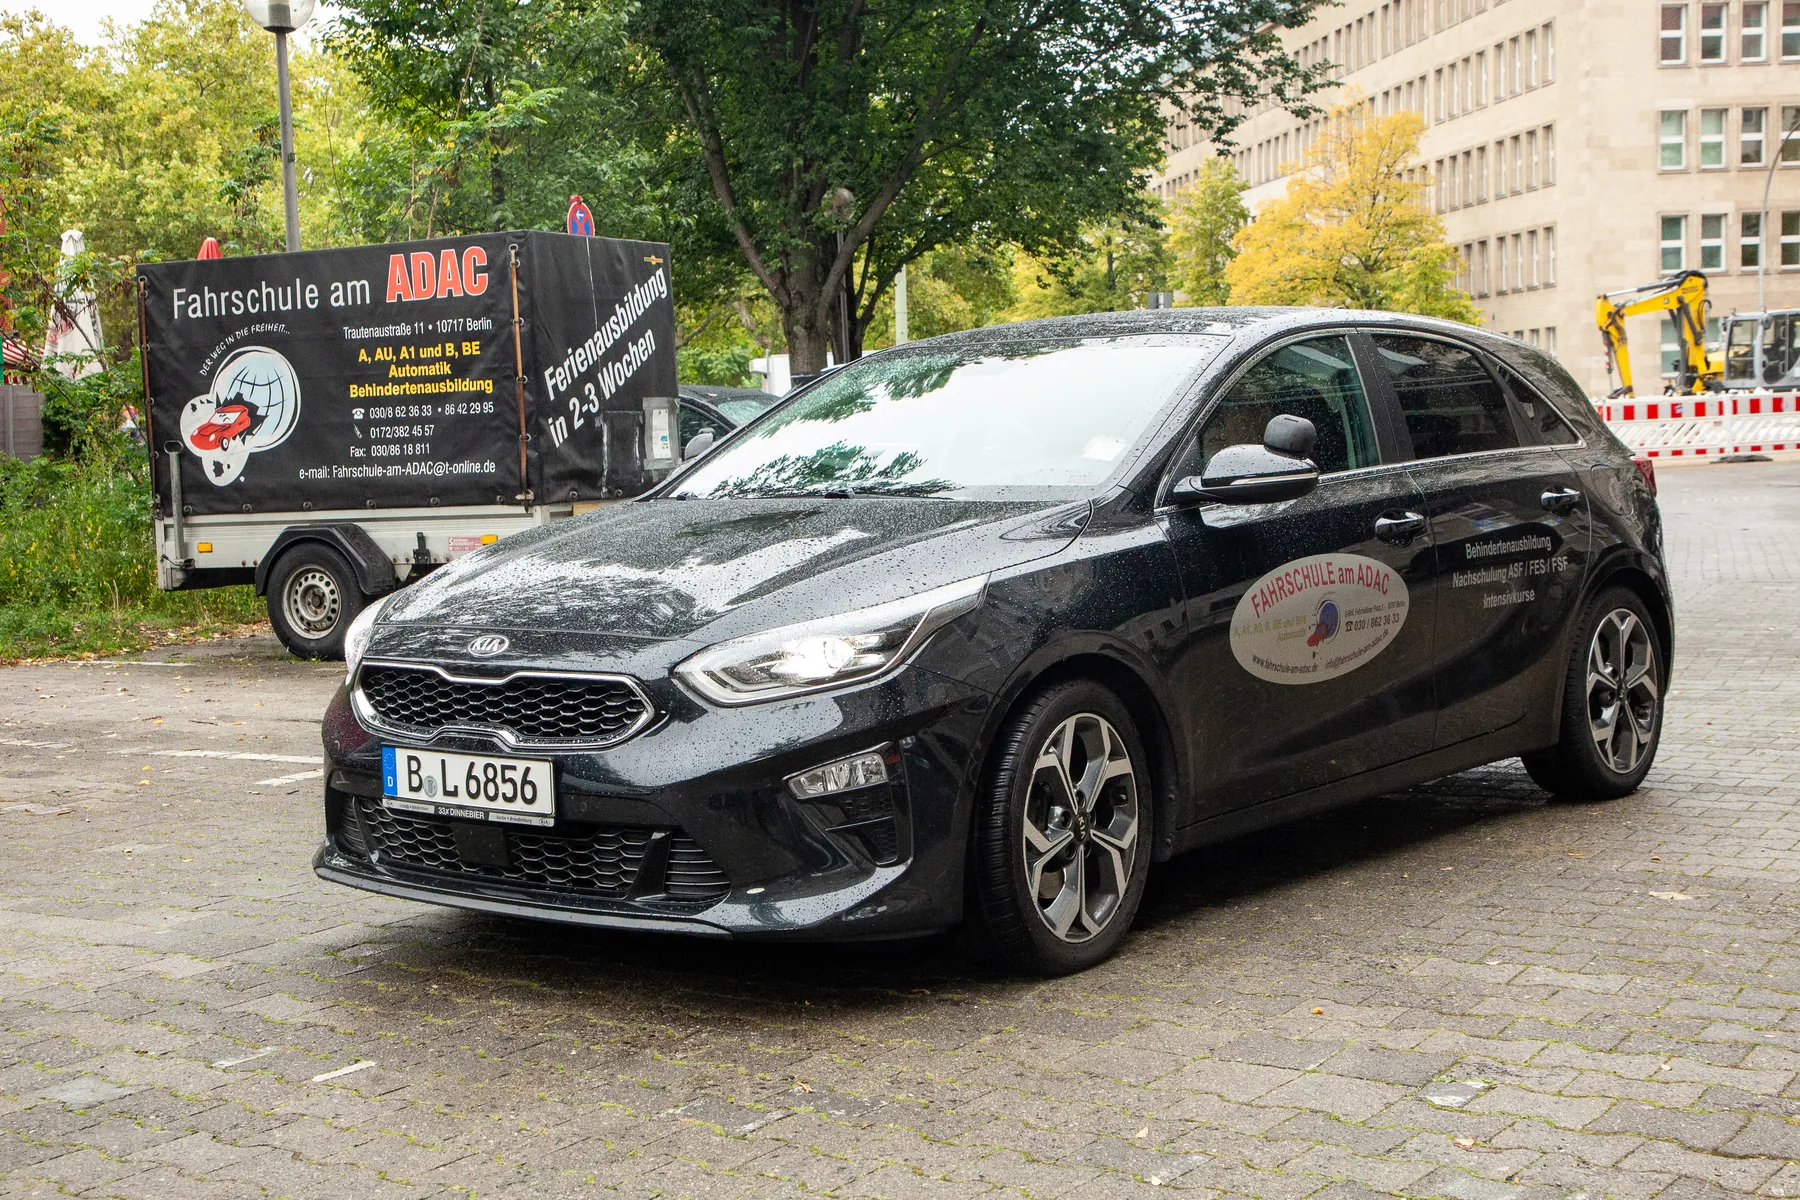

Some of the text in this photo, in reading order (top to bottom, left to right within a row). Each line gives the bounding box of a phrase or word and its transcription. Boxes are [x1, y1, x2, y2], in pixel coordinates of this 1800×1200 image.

[173, 246, 489, 320] Fahrschule am ADAC
[343, 317, 492, 340] Trautenaustraße 11 10717 Berlin
[544, 267, 667, 401] Ferienausbildung
[199, 359, 214, 377] DER
[210, 341, 227, 359] WEG
[225, 335, 235, 346] IN
[235, 327, 249, 340] DIE
[358, 348, 371, 364] A,
[399, 345, 415, 360] A1
[419, 343, 442, 359] und
[445, 342, 459, 358] B,
[462, 341, 481, 356] BE
[388, 361, 452, 378] Automatik
[349, 378, 493, 398] Behindertenausbildung
[548, 328, 656, 448] in 2-3 Wochen
[369, 401, 494, 420] 030/8 62 36 33 86 42 29 95
[370, 424, 435, 439] 0172/382 45 57
[350, 443, 430, 458] Fax: 030/86 18 811
[299, 459, 496, 480] e-mail: Fahrschule-am-ADAC@t-online.de
[1465, 535, 1552, 559] Behindertenausbildung
[1452, 566, 1507, 588] Nachschulung
[1508, 561, 1524, 579] ASF
[1529, 558, 1545, 576] FES
[1551, 556, 1569, 573] FSF
[1251, 562, 1336, 618] FAHRSCHULE
[1338, 566, 1355, 584] am
[1357, 563, 1390, 596] ADAC
[1483, 589, 1535, 609] Intensivkurse
[1354, 619, 1366, 631] 030
[1371, 616, 1382, 628] 862
[1383, 614, 1391, 625] 36
[1392, 612, 1400, 624] 33
[387, 776, 394, 787] D
[407, 754, 538, 805] B L 6856
